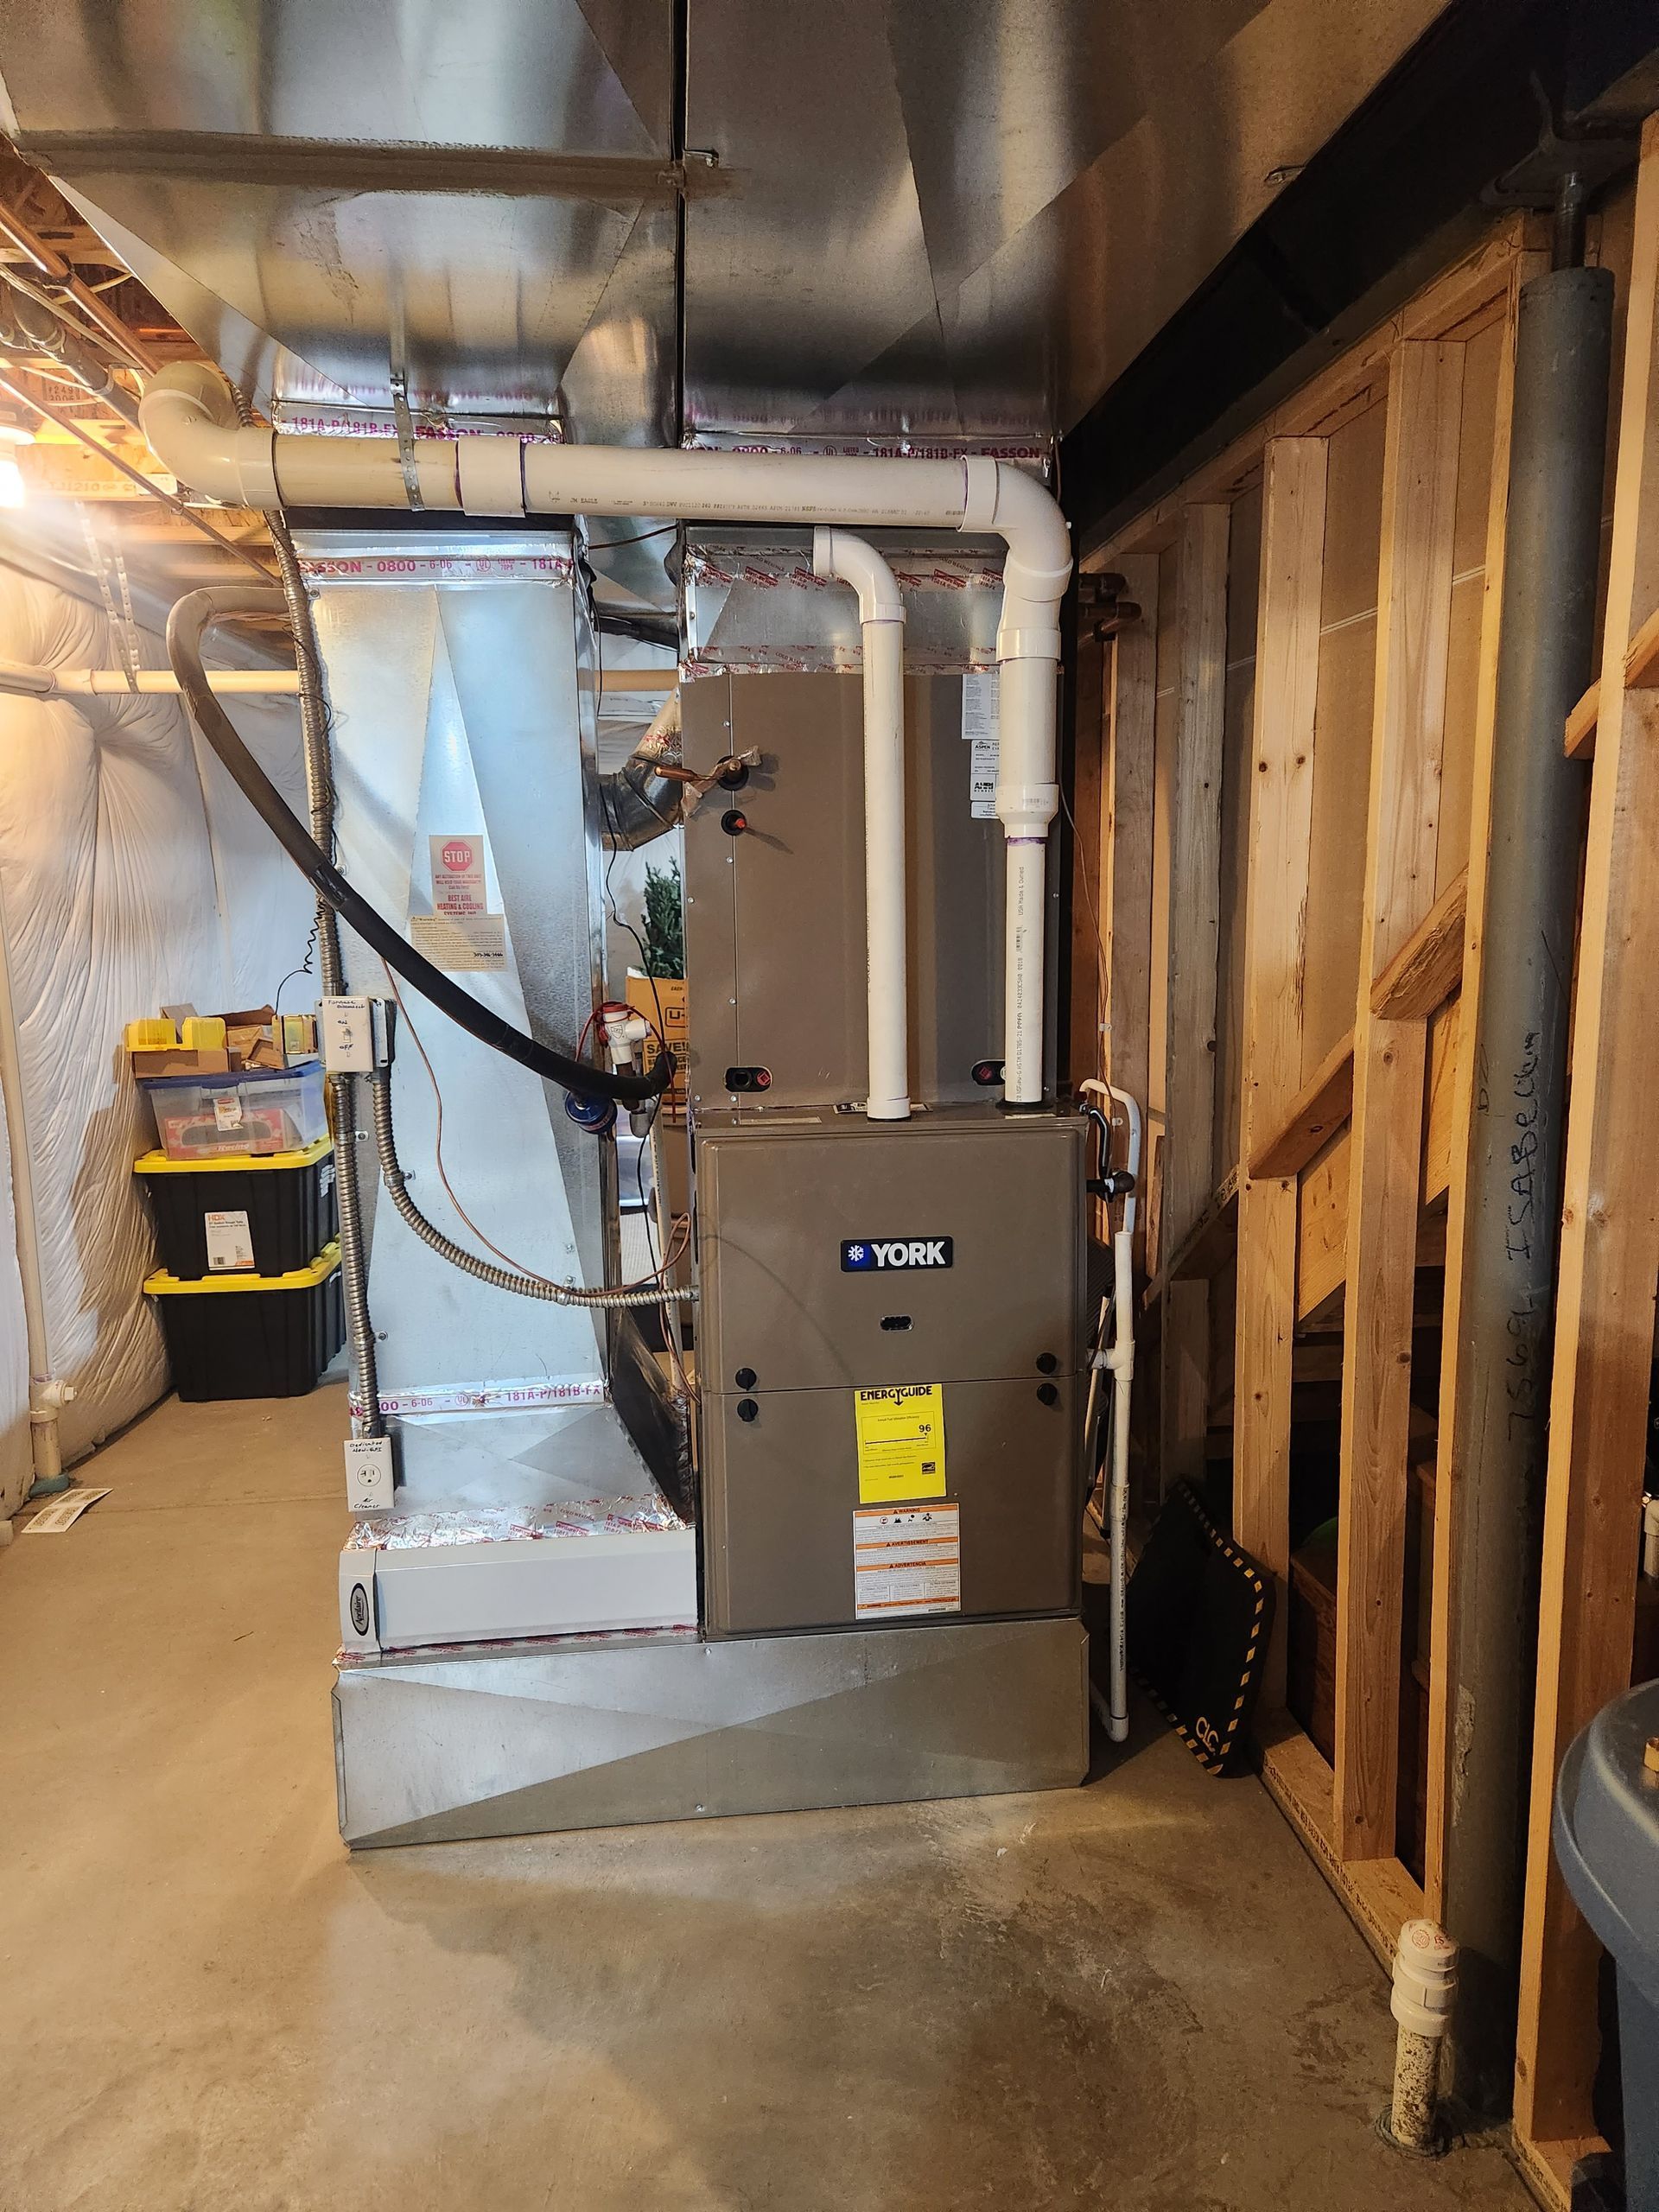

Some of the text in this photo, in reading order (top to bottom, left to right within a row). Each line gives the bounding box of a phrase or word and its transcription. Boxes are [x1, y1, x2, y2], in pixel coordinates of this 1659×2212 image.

[981, 448, 1040, 460] FASSON
[377, 559, 416, 573] 0800
[429, 558, 453, 569] 6-06
[444, 850, 471, 863] STOP
[436, 902, 457, 911] HEATING
[207, 1213, 226, 1222] HDX
[871, 1241, 946, 1268] YORK
[860, 1385, 933, 1404] ENERGYGUIDE
[410, 1396, 434, 1408] 6-06
[918, 1424, 931, 1433] 96
